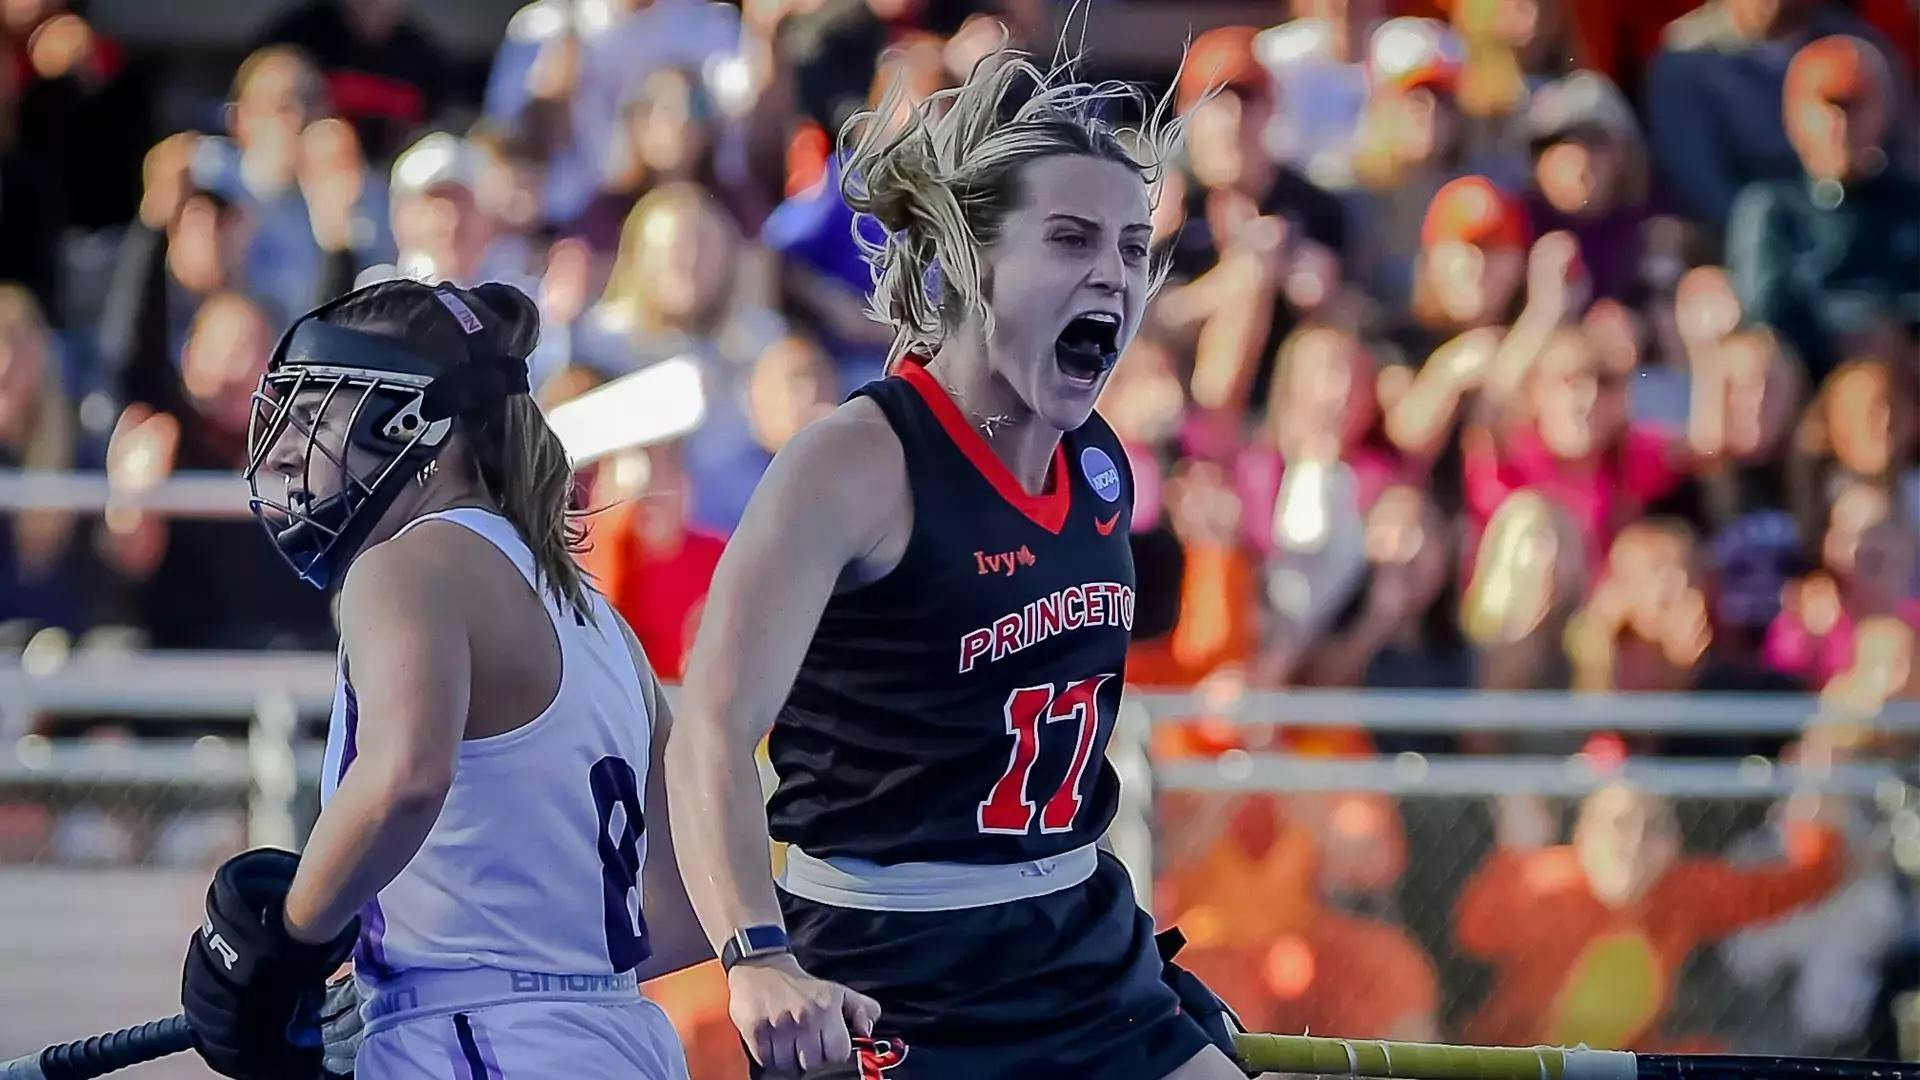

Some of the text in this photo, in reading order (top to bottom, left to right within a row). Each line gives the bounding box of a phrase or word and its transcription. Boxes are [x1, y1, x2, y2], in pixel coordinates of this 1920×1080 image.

[1092, 468, 1119, 490] NCAA
[973, 551, 1015, 577] Ivy
[959, 582, 1135, 673] PRINCETO
[977, 673, 1116, 835] 17
[588, 756, 651, 974] 8
